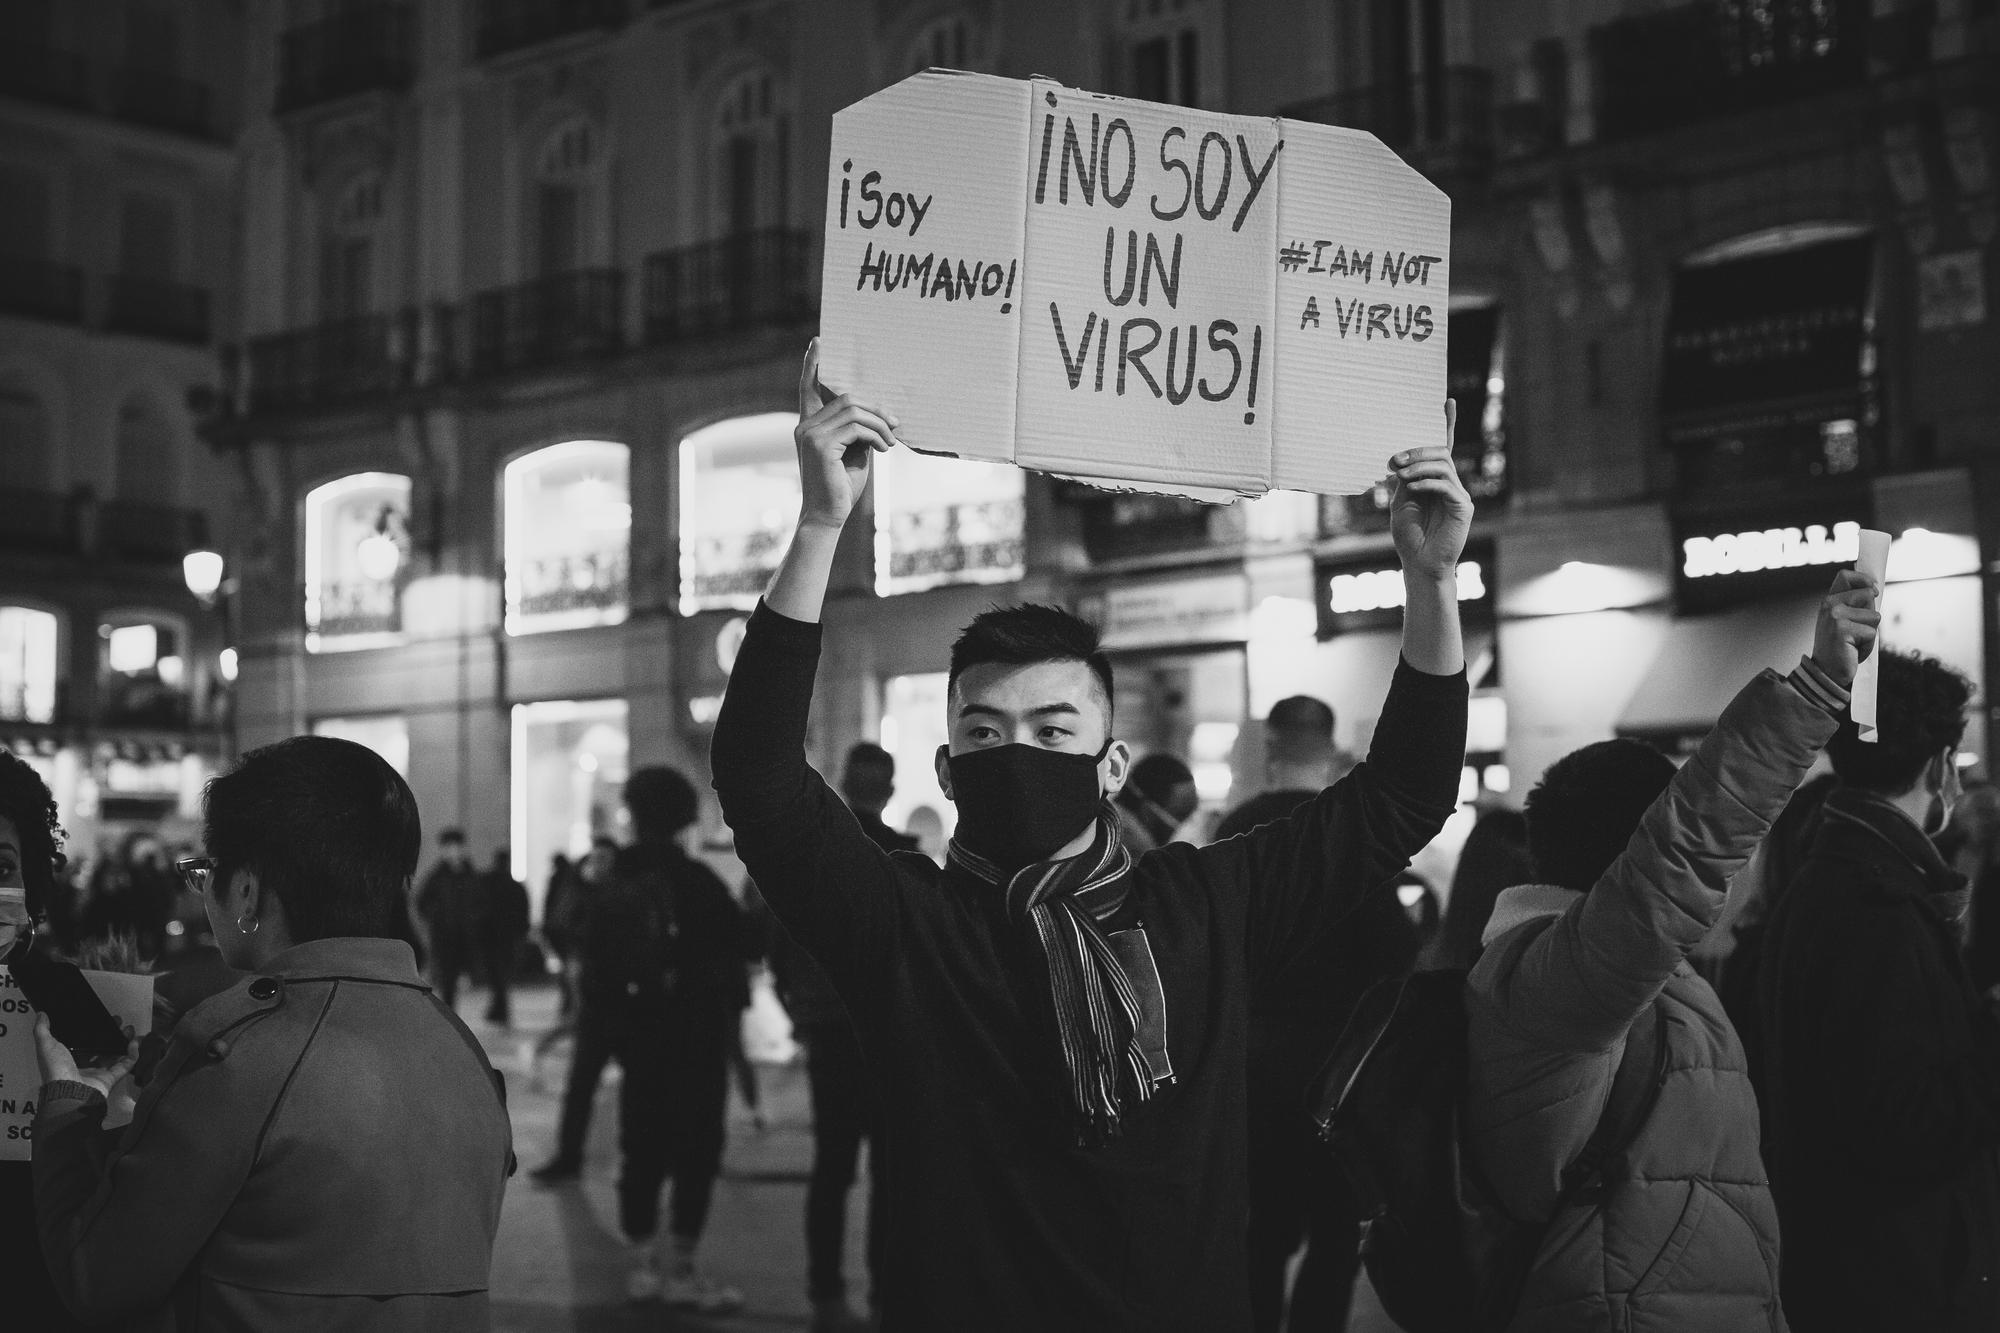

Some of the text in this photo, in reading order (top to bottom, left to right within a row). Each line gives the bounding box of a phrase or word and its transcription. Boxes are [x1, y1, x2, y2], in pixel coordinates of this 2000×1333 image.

[1035, 90, 1285, 232] ¡NO SOY
[857, 242, 1016, 314] HUMANO!
[1103, 226, 1183, 309] UN
[1380, 251, 1443, 288] NOT
[1300, 295, 1434, 342] A VIRUS
[1050, 301, 1262, 425] VIRUS!
